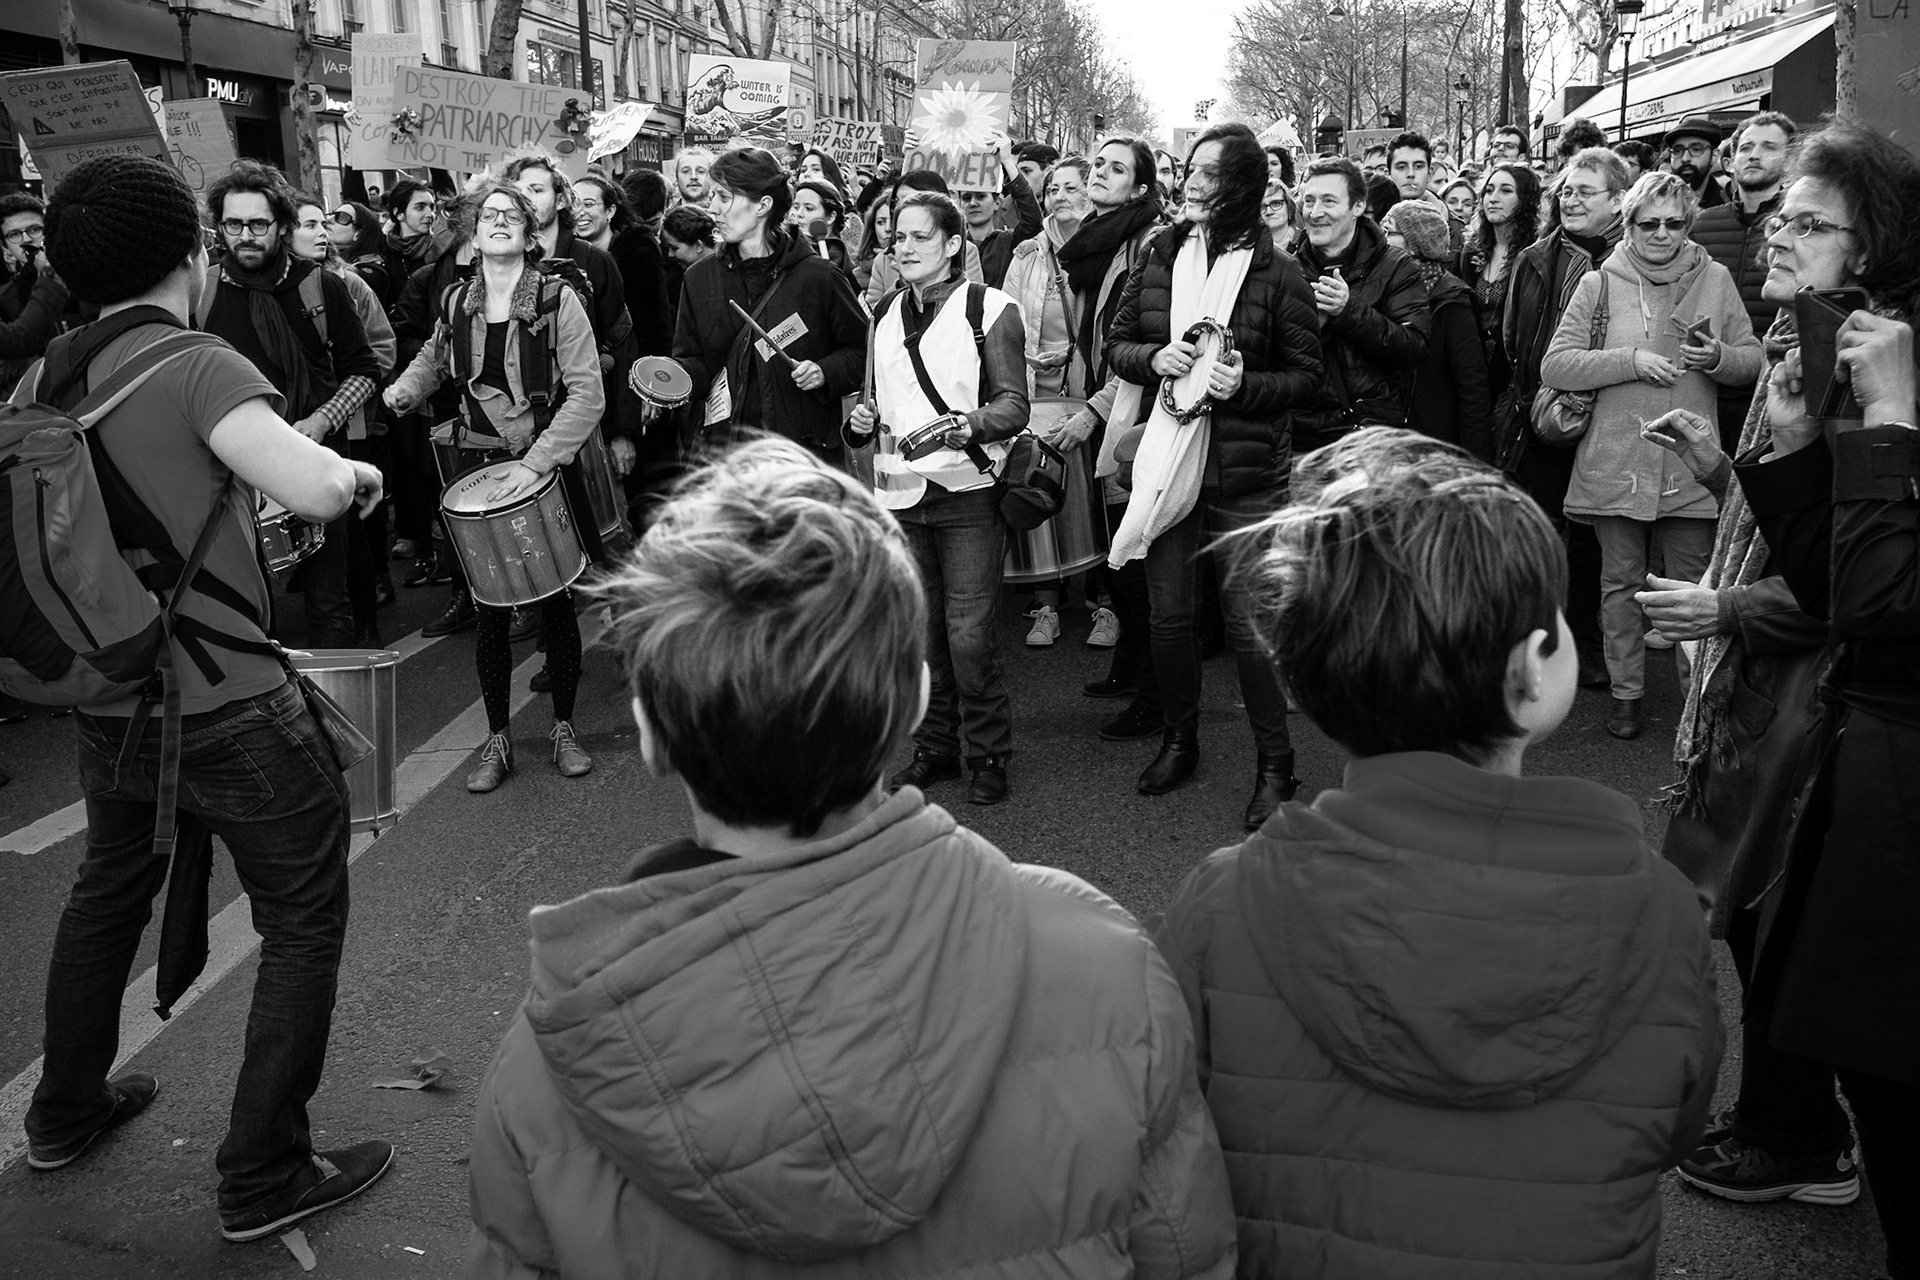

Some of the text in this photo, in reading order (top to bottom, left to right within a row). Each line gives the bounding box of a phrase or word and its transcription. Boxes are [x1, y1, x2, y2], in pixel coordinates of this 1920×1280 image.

[8, 73, 119, 98] CEUX QUI PENSENT
[80, 82, 130, 99] IMPOSSIBLE
[206, 77, 238, 102] PMU
[404, 70, 562, 117] DESTROY THE
[741, 80, 783, 94] WATER IS
[1732, 75, 1764, 94] Restaurant
[740, 92, 780, 104] COMING
[69, 116, 108, 130] NE PAS
[419, 102, 551, 149] PATRIARCHY
[813, 118, 876, 140] DESTROY
[694, 134, 709, 142] BAR
[812, 134, 830, 147] MY
[831, 136, 854, 150] ASS
[857, 141, 878, 152] NOT
[1356, 137, 1376, 149] ACT
[403, 142, 456, 166] NOT
[462, 151, 491, 169] THE
[908, 150, 1000, 187] POWER
[460, 471, 492, 493] GOPE
